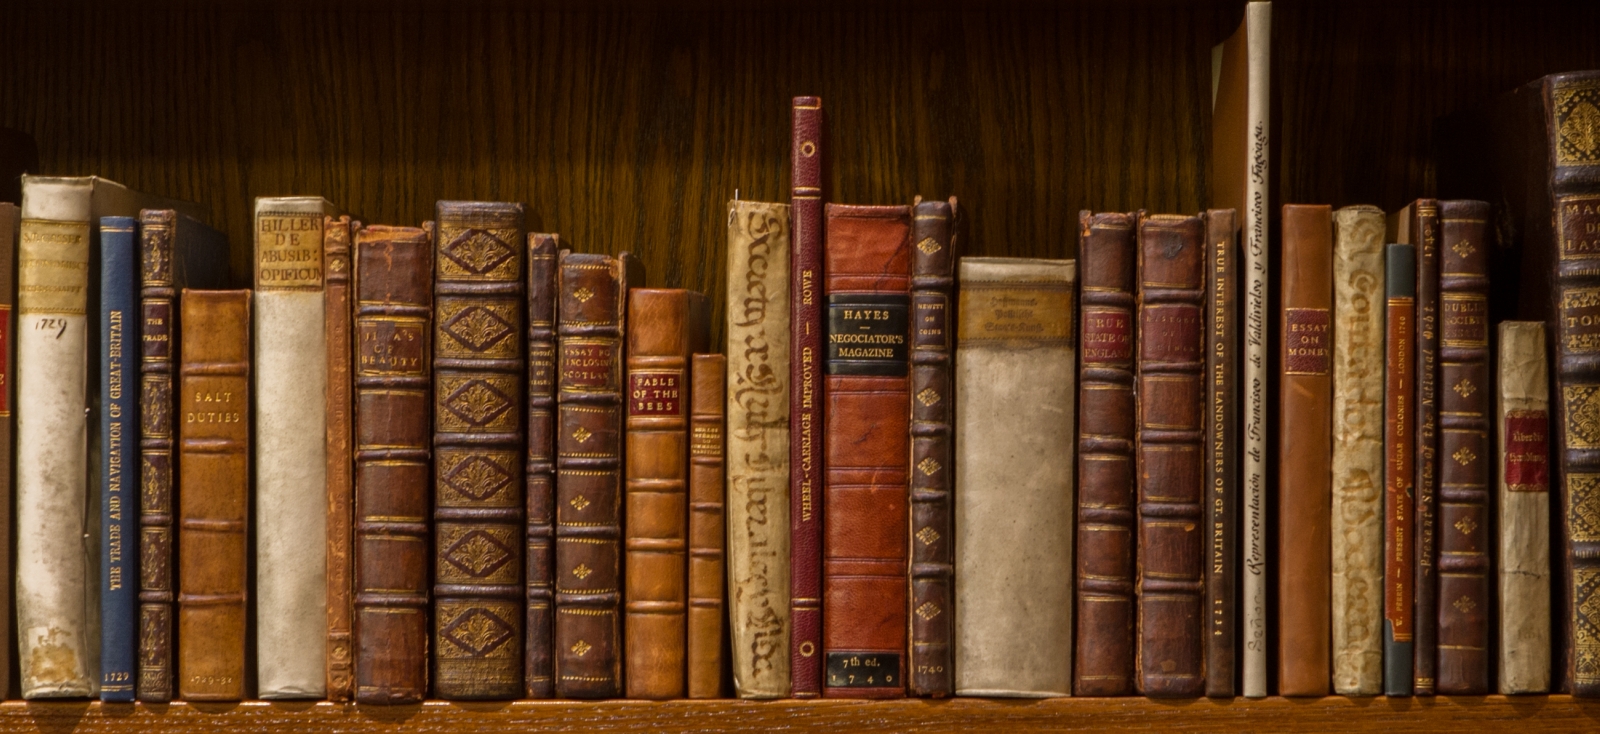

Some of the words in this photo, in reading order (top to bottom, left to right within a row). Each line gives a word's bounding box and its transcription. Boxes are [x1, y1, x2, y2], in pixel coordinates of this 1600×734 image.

[261, 219, 319, 232] HILLER
[1249, 191, 1263, 257] Francisco
[275, 233, 300, 246] DE
[1215, 241, 1225, 273] TRUE
[1254, 262, 1266, 274] y
[803, 270, 812, 305] ROWE
[843, 310, 889, 320] HAYES
[1215, 277, 1224, 337] INTEREST
[35, 318, 67, 339] 1729
[146, 318, 163, 326] THE
[1291, 323, 1328, 332] ESSAY
[143, 334, 168, 342] TRADE
[829, 334, 904, 344] NEGOCIATOR'S
[1084, 332, 1116, 343] STATE
[1300, 335, 1319, 345] ON
[109, 310, 122, 399] GREAT-BRITAIN
[838, 348, 894, 358] MAGAZINE
[1215, 342, 1224, 358] OF
[1288, 347, 1329, 356] MONEY
[1397, 338, 1406, 374] LONDON
[361, 355, 418, 367] BEAUTY
[1248, 354, 1261, 369] de
[637, 378, 674, 387] FABLE
[803, 347, 812, 408] IMPROVED
[1215, 363, 1224, 386] THE
[1422, 349, 1434, 408] National
[195, 392, 232, 403] SALT
[633, 390, 647, 399] OF
[653, 390, 678, 399] THE
[109, 402, 122, 418] OF
[638, 402, 673, 411] BEES
[1247, 377, 1261, 442] Francisco
[187, 412, 240, 423] DUTIES
[1396, 395, 1405, 437] COLONIES
[1215, 391, 1224, 473] LANDOWNERS
[109, 422, 122, 492] NAVIGATION
[1248, 447, 1261, 463] de
[1396, 443, 1405, 471] SUGAR
[802, 413, 812, 522] WHEEL-CARRIAGE
[1215, 477, 1223, 494] OF
[1396, 477, 1404, 488] OF
[109, 495, 122, 521] AND
[1214, 498, 1223, 517] GT.
[1396, 494, 1404, 521] STATE
[1247, 473, 1265, 576] Representación
[109, 524, 122, 563] TRADE
[1214, 522, 1223, 574] BRITAIN
[1396, 526, 1404, 562] PRESENT
[109, 566, 122, 591] THE
[1396, 583, 1404, 612] PERRIN
[1213, 599, 1223, 636] 1734
[843, 656, 860, 669] 7th
[864, 657, 880, 667] ed.
[917, 665, 943, 675] 1740
[104, 672, 129, 682] 1729
